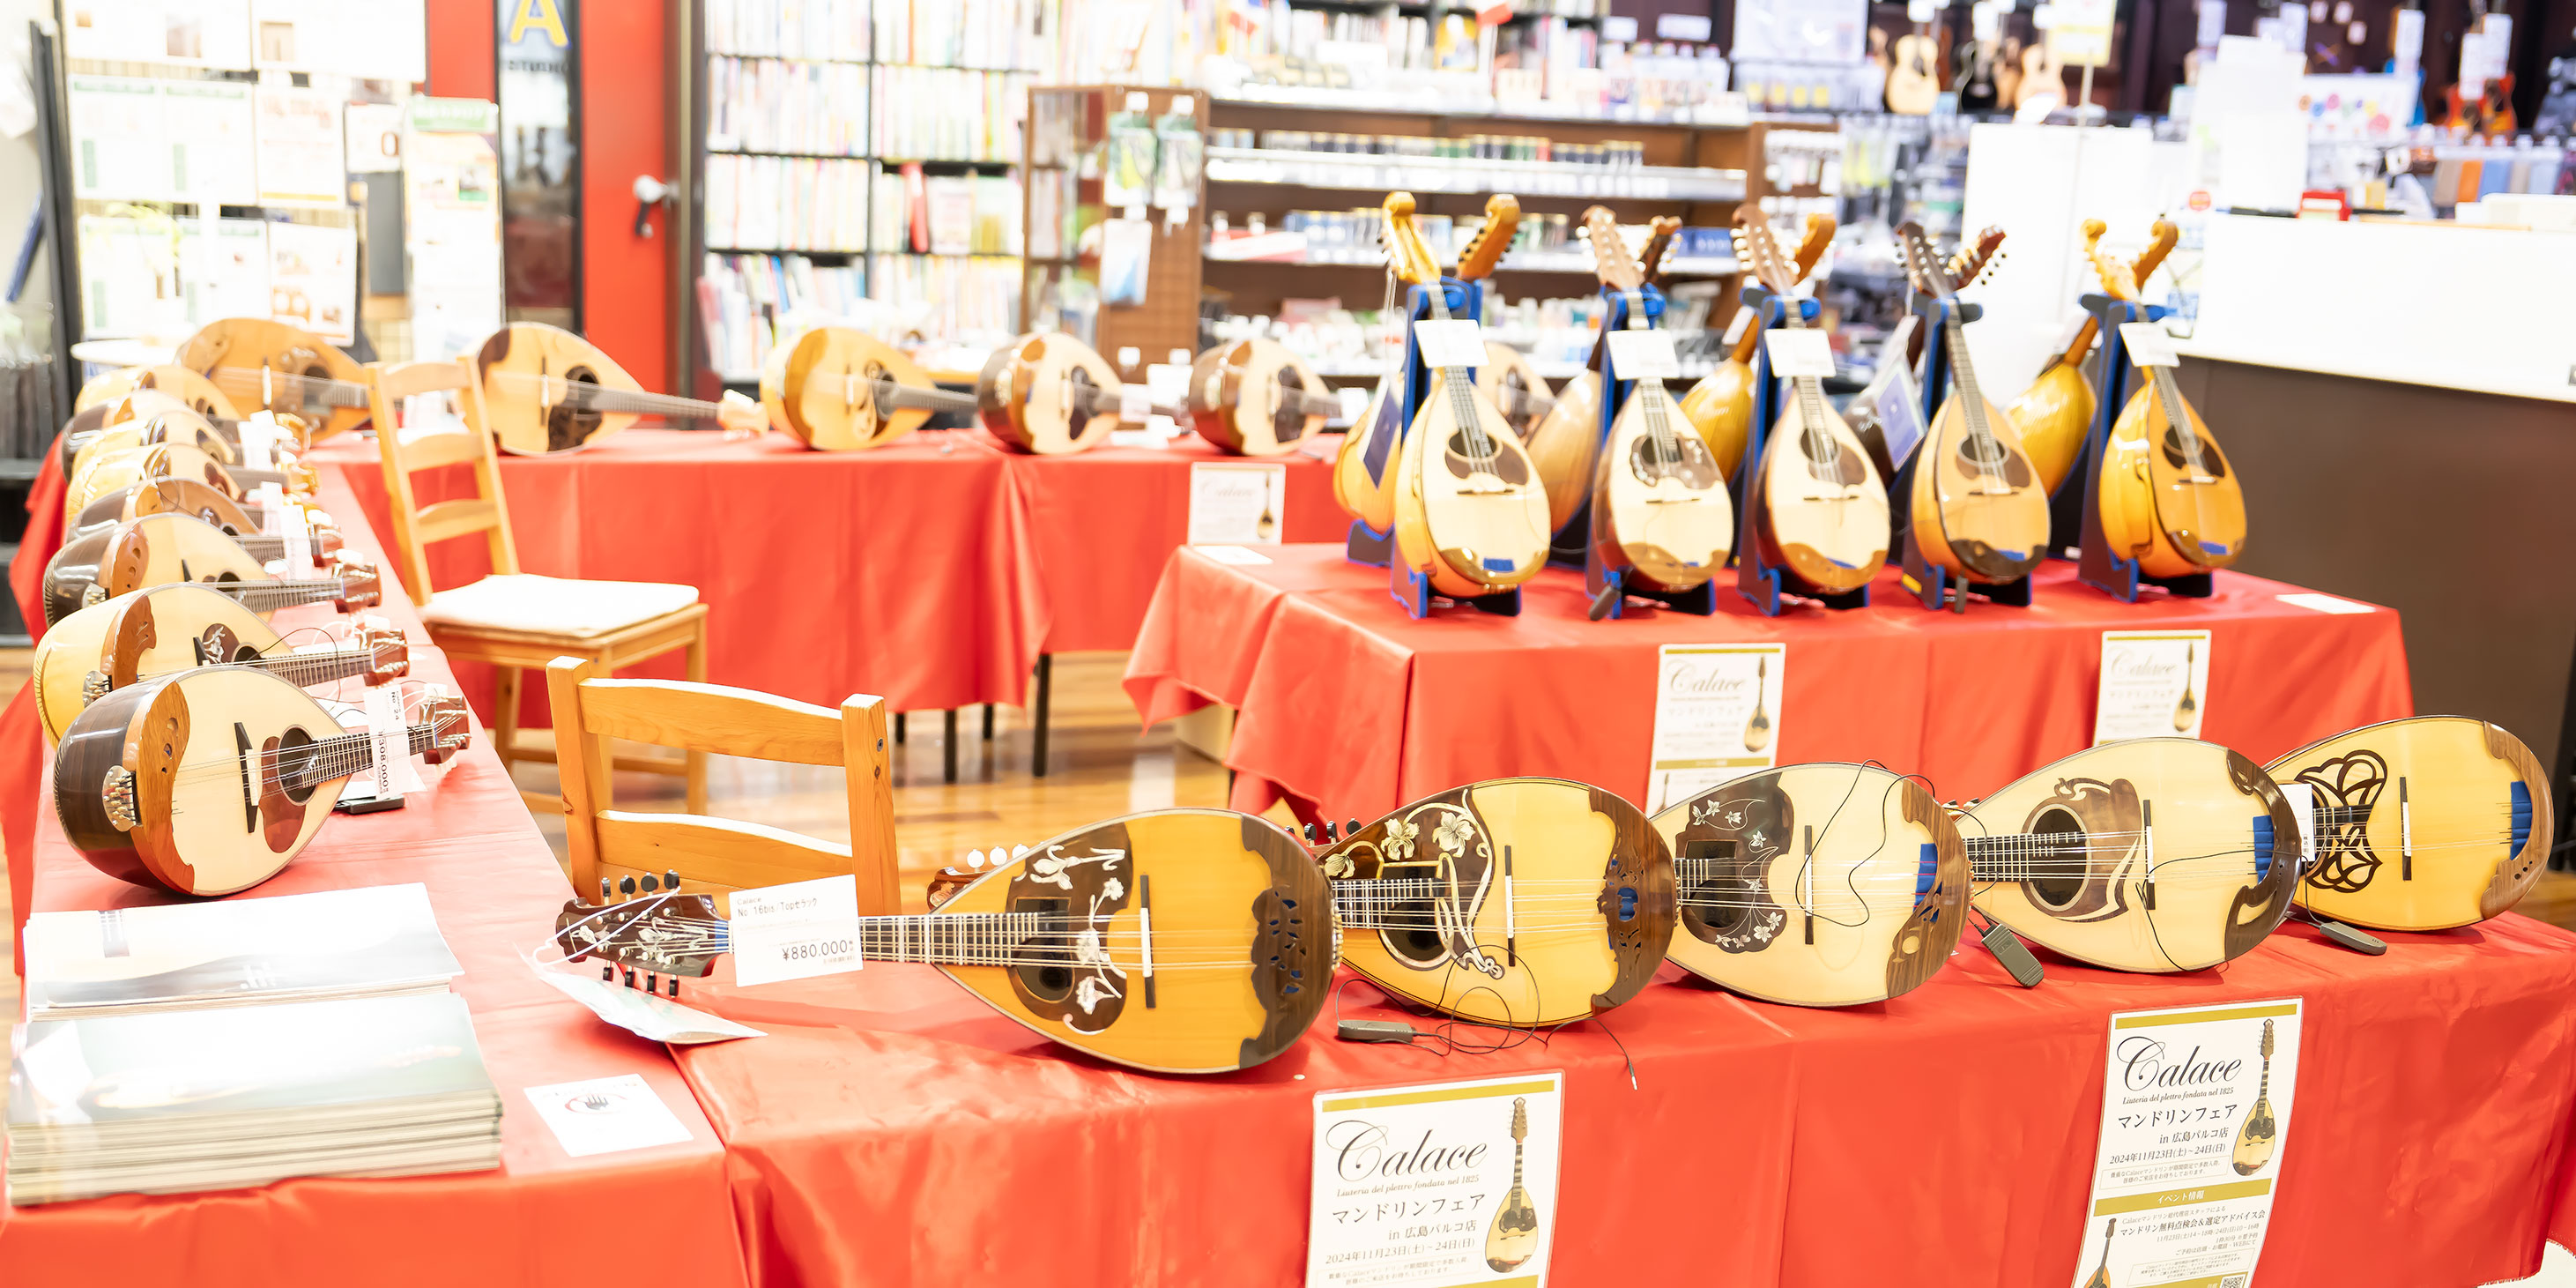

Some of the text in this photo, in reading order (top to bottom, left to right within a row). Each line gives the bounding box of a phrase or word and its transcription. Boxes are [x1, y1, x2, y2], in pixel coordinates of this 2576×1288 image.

[2116, 1036, 2242, 1091] Calace
[2149, 1092, 2159, 1102] del
[2159, 1091, 2182, 1102] plettro
[2182, 1089, 2207, 1100] fondata
[2209, 1088, 2219, 1097] nel
[2219, 1086, 2234, 1096] 1825
[2118, 1104, 2238, 1130] マンドリンフェア
[2159, 1128, 2229, 1144] in 広島パルコ店
[1325, 1120, 1488, 1181] Calace
[1371, 1185, 1384, 1194] del
[1385, 1182, 1413, 1195] plettro
[1414, 1180, 1445, 1190] fondata
[1447, 1177, 1459, 1186] nel
[1461, 1174, 1480, 1184] 1825
[2157, 1190, 2205, 1204] イベント情報
[1332, 1193, 1486, 1225] マンドリンフェア
[1388, 1230, 1400, 1240] in
